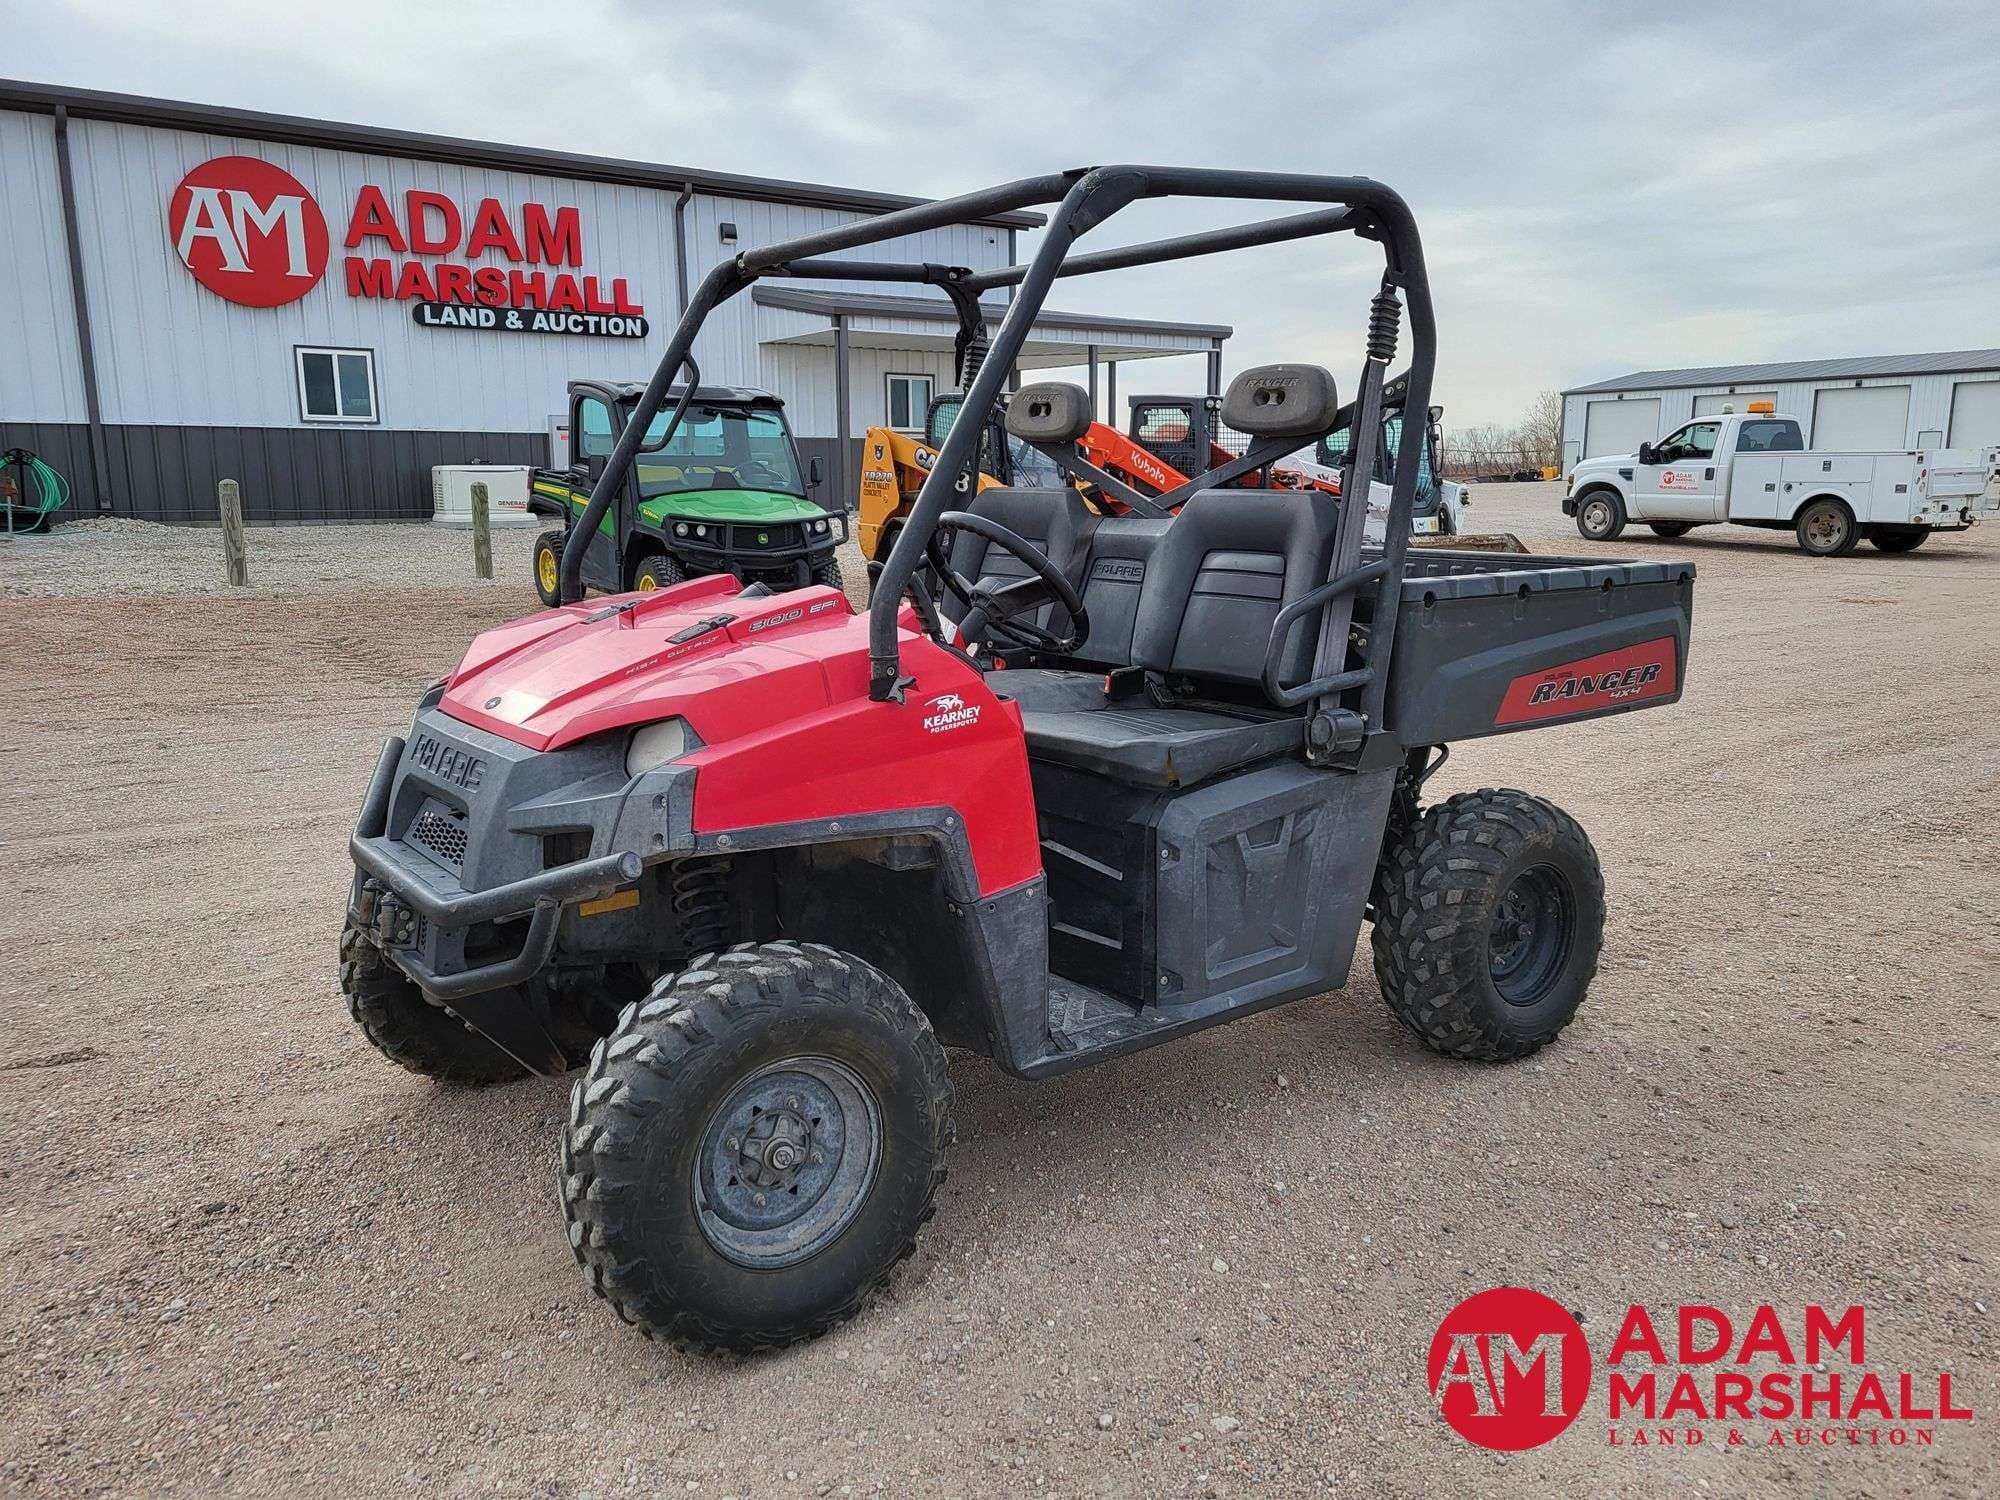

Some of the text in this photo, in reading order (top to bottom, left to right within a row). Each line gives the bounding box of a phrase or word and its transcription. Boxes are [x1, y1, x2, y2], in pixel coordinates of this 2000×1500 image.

[176, 185, 314, 278] AM
[344, 184, 583, 268] ADAM
[344, 256, 645, 316] MARSHALL
[424, 304, 643, 337] LAND & AUCTION
[1130, 450, 1166, 486] Kubota
[1094, 562, 1143, 577] POLARIS
[750, 599, 839, 632] 800 EFI
[666, 636, 722, 659] OUTPUT
[1528, 662, 1662, 705] RANGER
[924, 705, 981, 729] KEARNEY
[930, 718, 978, 733] POWERSPORTS
[410, 734, 488, 794] POLARIS
